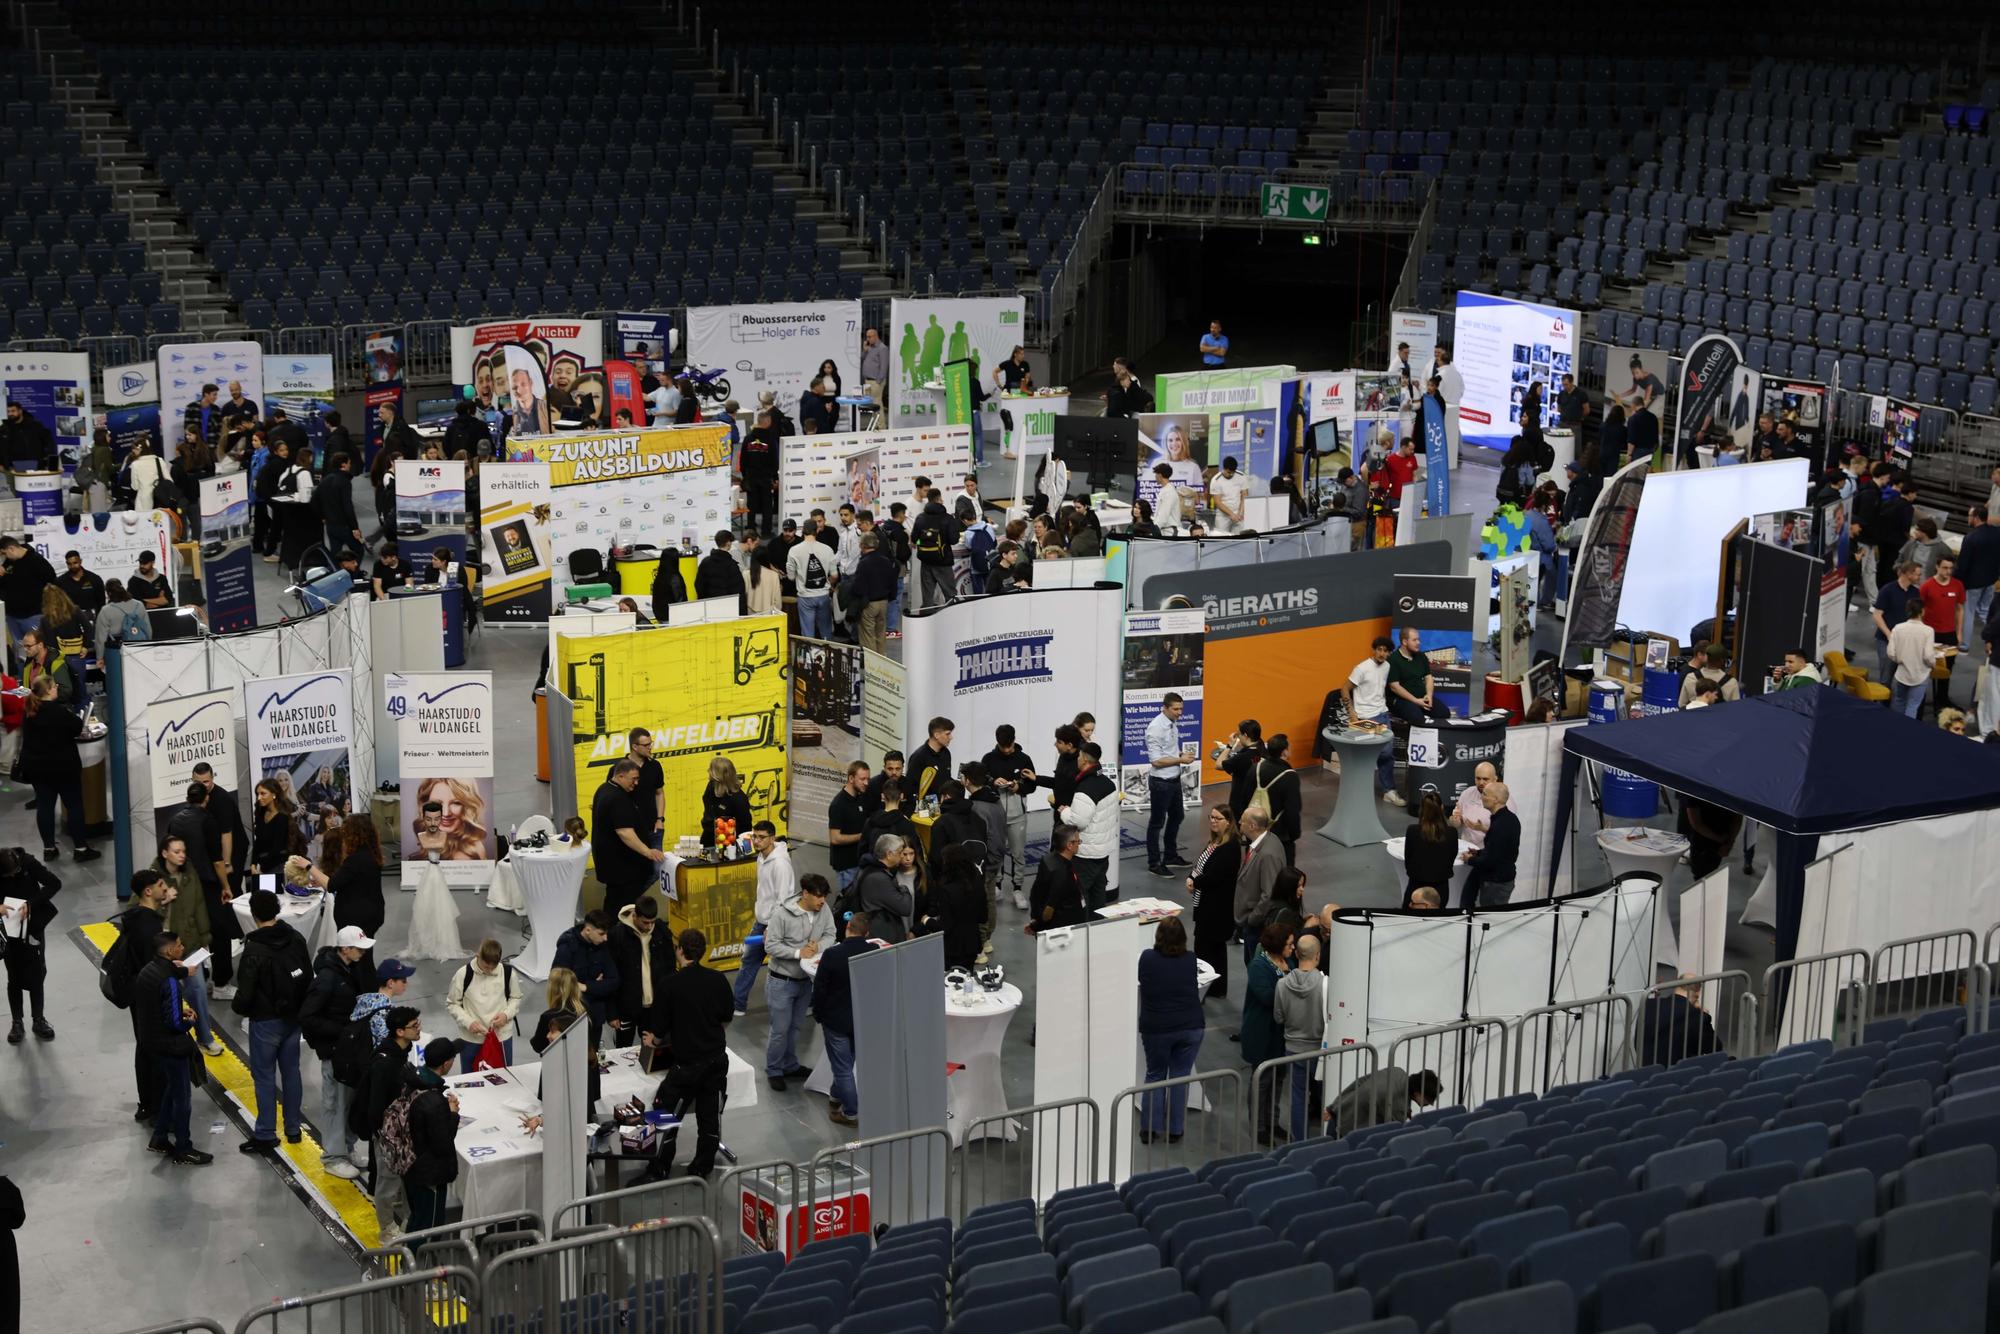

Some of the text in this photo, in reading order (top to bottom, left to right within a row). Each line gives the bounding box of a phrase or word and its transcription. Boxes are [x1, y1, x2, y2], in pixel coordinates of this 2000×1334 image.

[742, 312, 825, 325] Abwasserservice
[999, 309, 1019, 324] rahm
[537, 327, 574, 337] Nicht!
[762, 326, 797, 340] Holger
[846, 320, 856, 332] 77
[549, 435, 641, 462] ZUKUNFT
[573, 448, 704, 480] AUSBILDUNG
[490, 480, 540, 491] erhältlich
[1203, 587, 1319, 619] GIERATHS
[1417, 600, 1469, 610] GIERATHS
[955, 628, 1054, 648] FORMEN- UND WERKZEUGBAU
[961, 645, 1033, 681] PAKULLA
[953, 676, 1053, 697] CAD/CAM-KONSTRUKTIONEN
[1125, 693, 1149, 701] Komm
[387, 695, 406, 716] 49
[1125, 705, 1160, 714] Wir bilden
[262, 735, 347, 752] Weltmeisterbetrieb
[591, 715, 760, 759] APNFELDER
[437, 749, 489, 757] Weltmeisterin
[1410, 744, 1427, 763] 52
